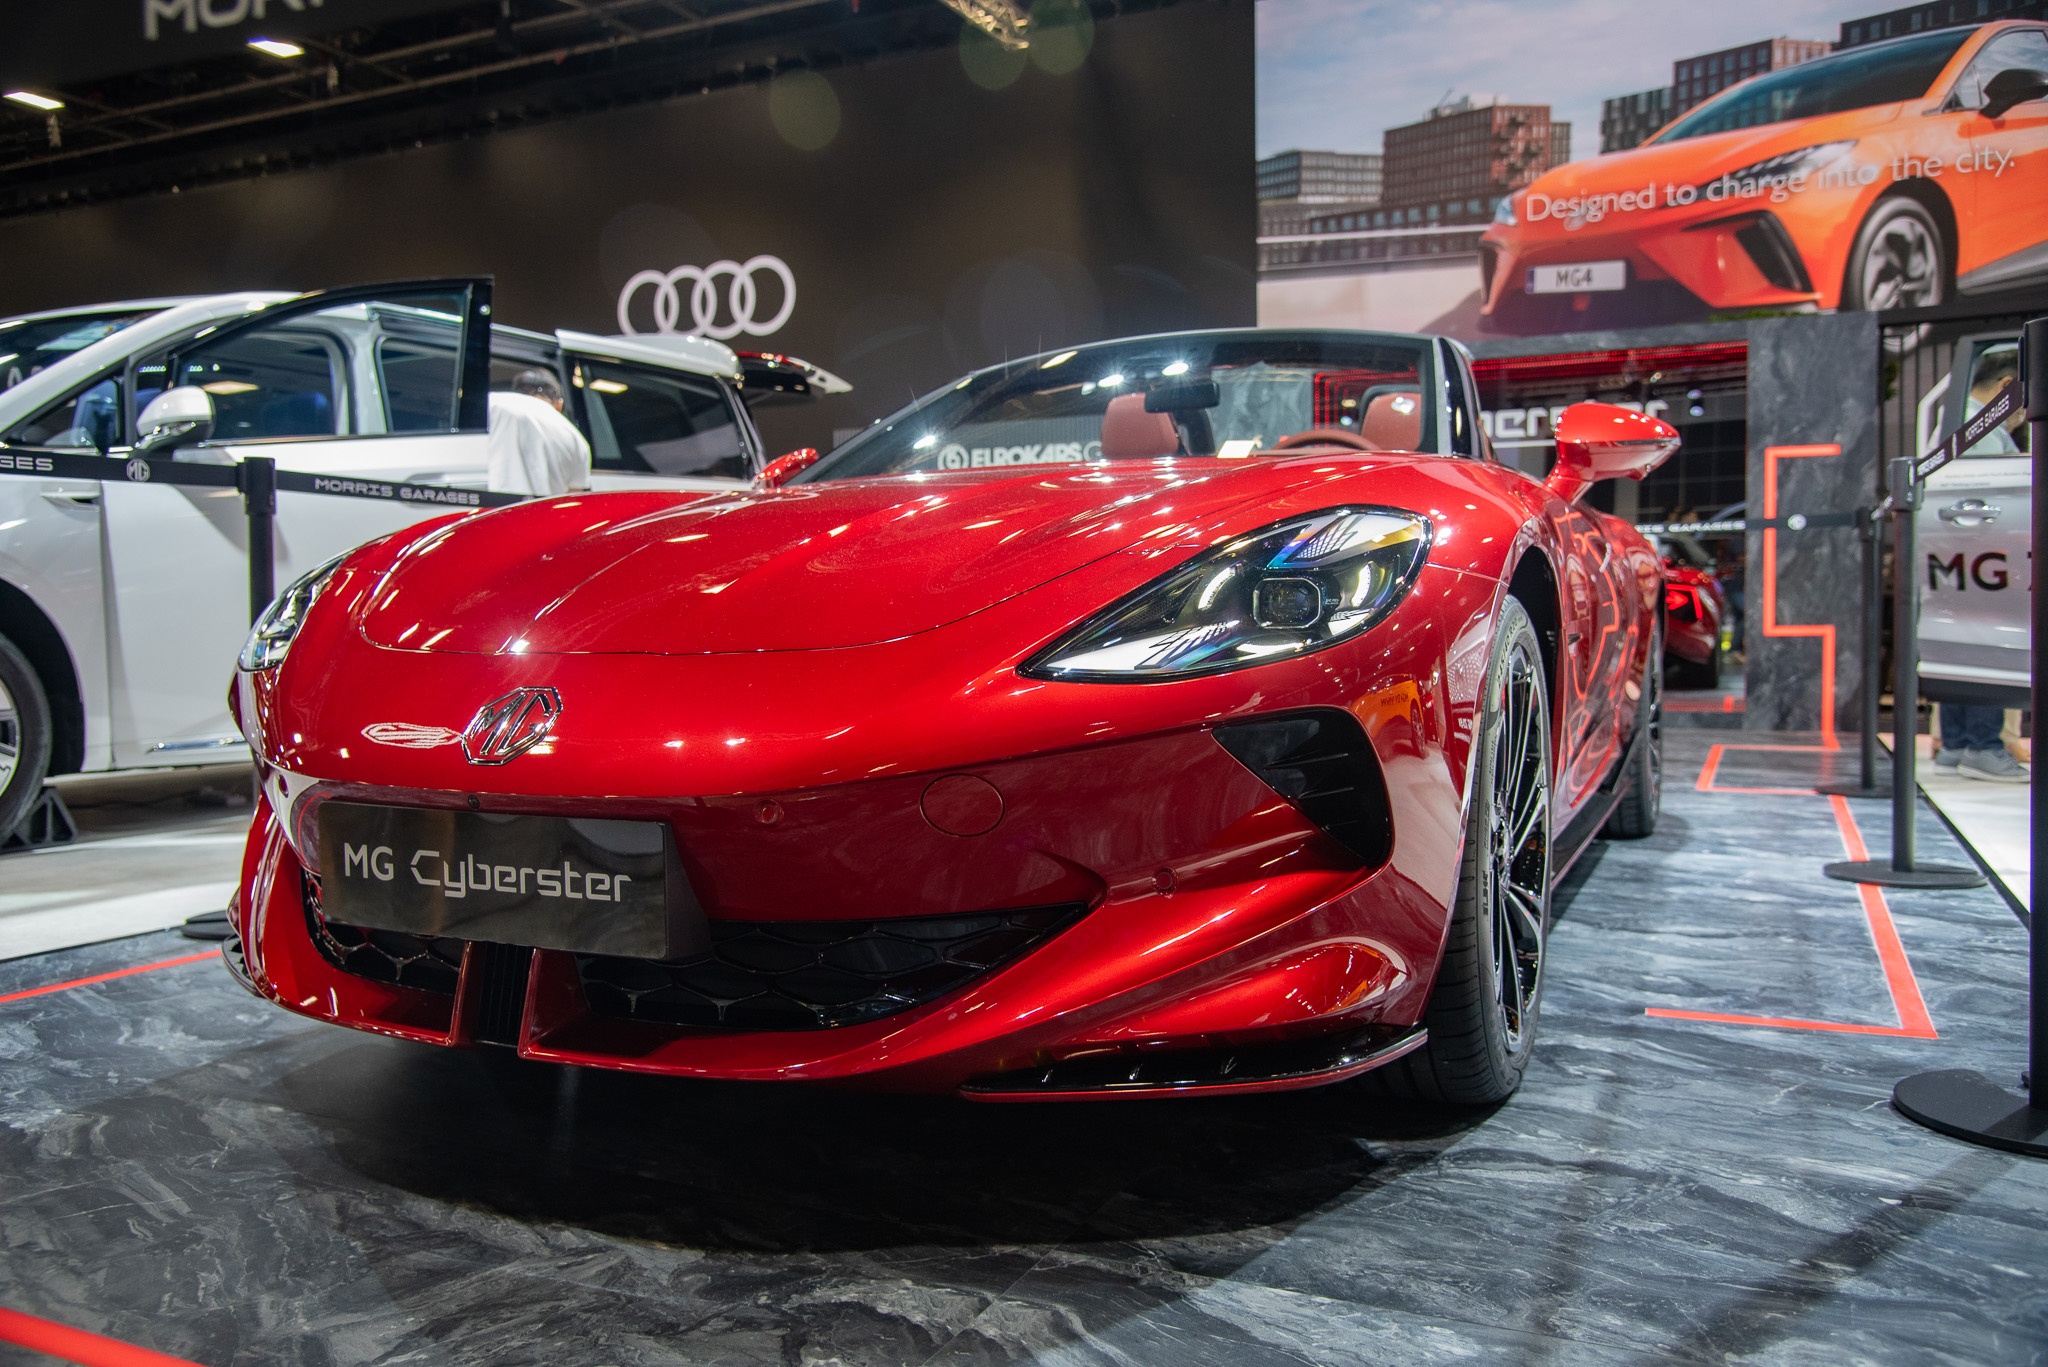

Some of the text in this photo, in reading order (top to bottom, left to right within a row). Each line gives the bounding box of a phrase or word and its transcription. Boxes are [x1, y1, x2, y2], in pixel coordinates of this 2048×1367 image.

[1526, 143, 2016, 222] Designed to charge into the city.
[1555, 267, 1593, 288] MG4
[315, 477, 480, 505] MORRIS GARAGES
[1927, 552, 2008, 592] MG
[464, 688, 558, 762] MG
[344, 842, 633, 902] MG Cyberster
